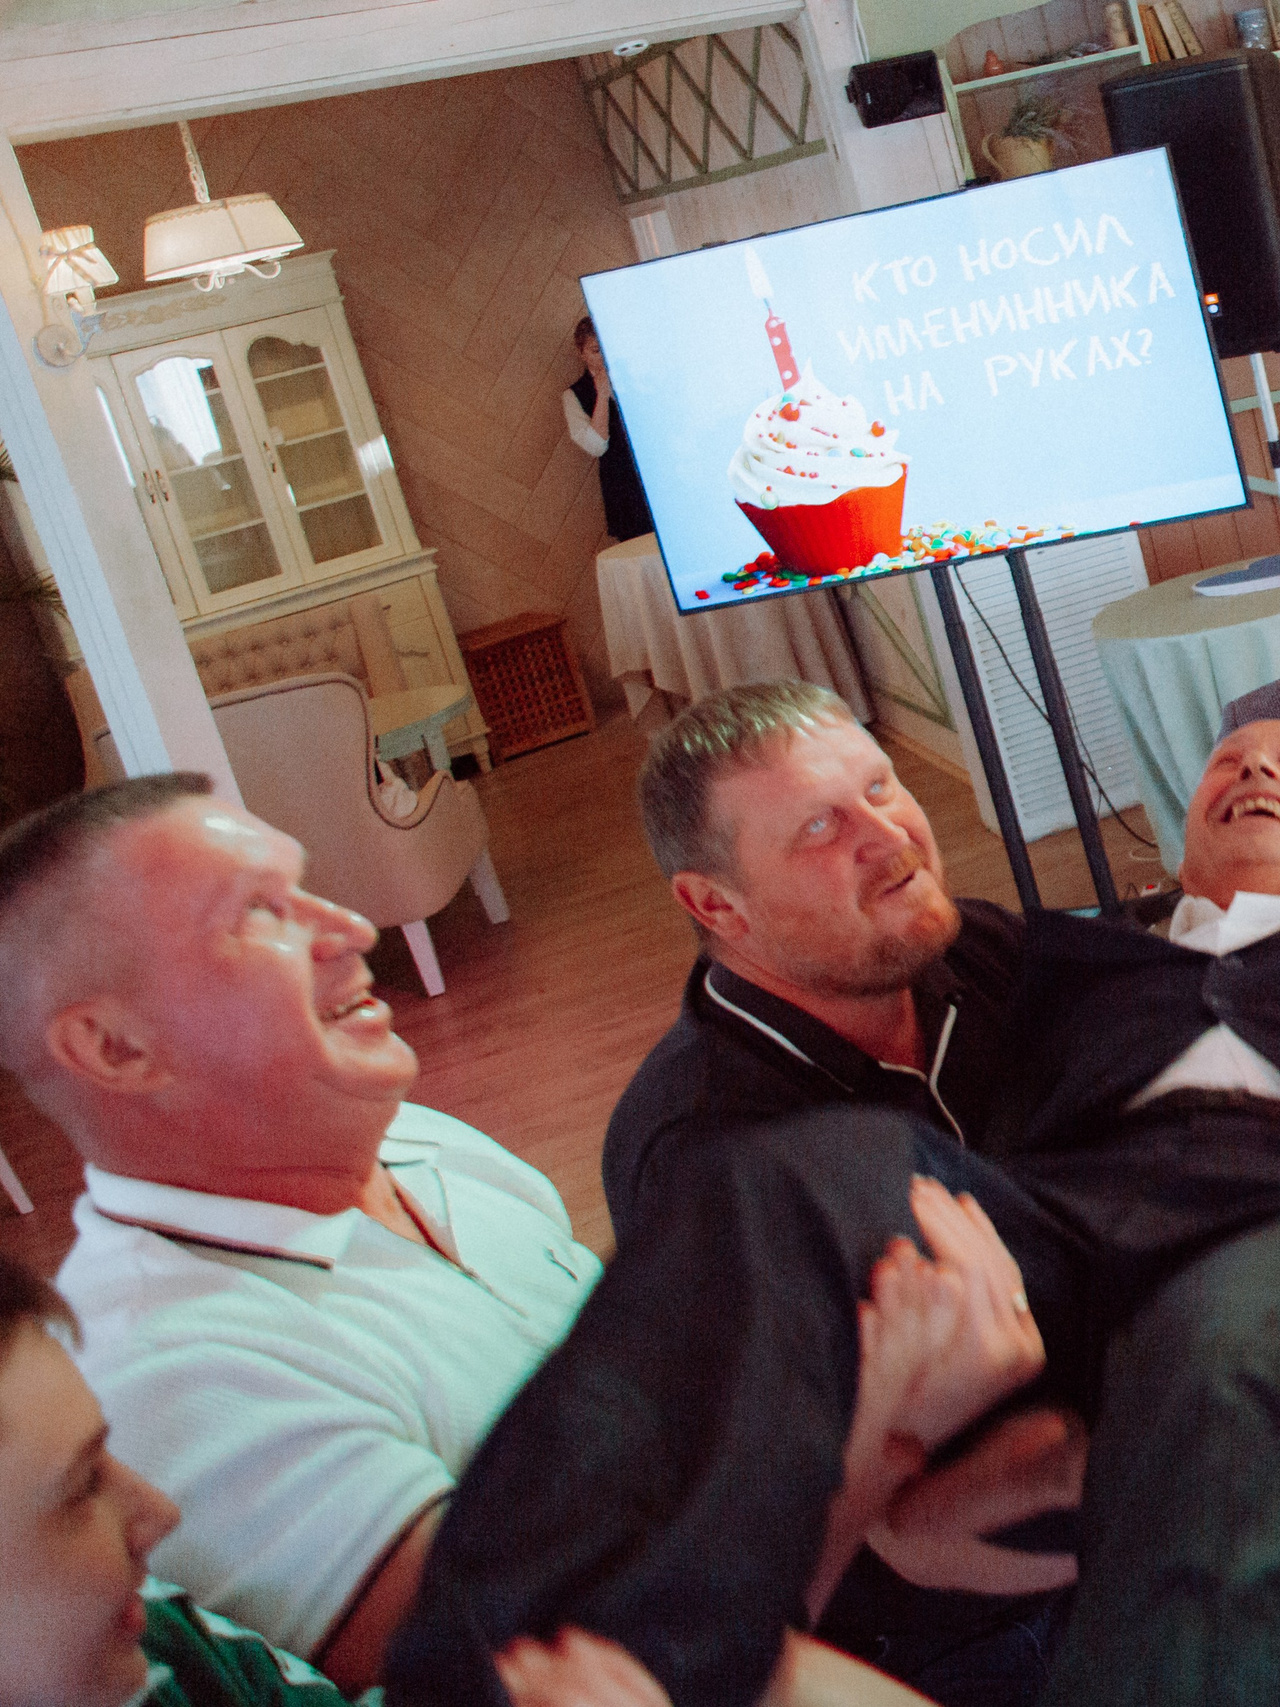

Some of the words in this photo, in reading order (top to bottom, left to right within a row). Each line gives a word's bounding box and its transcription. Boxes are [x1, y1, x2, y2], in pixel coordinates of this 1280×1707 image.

[852, 255, 937, 303] КТО
[958, 213, 1134, 281] НОСИЛ
[837, 262, 1176, 364] ИМЕНИННИКА
[884, 371, 944, 416] НА
[983, 328, 1154, 397] РУКАХ?
